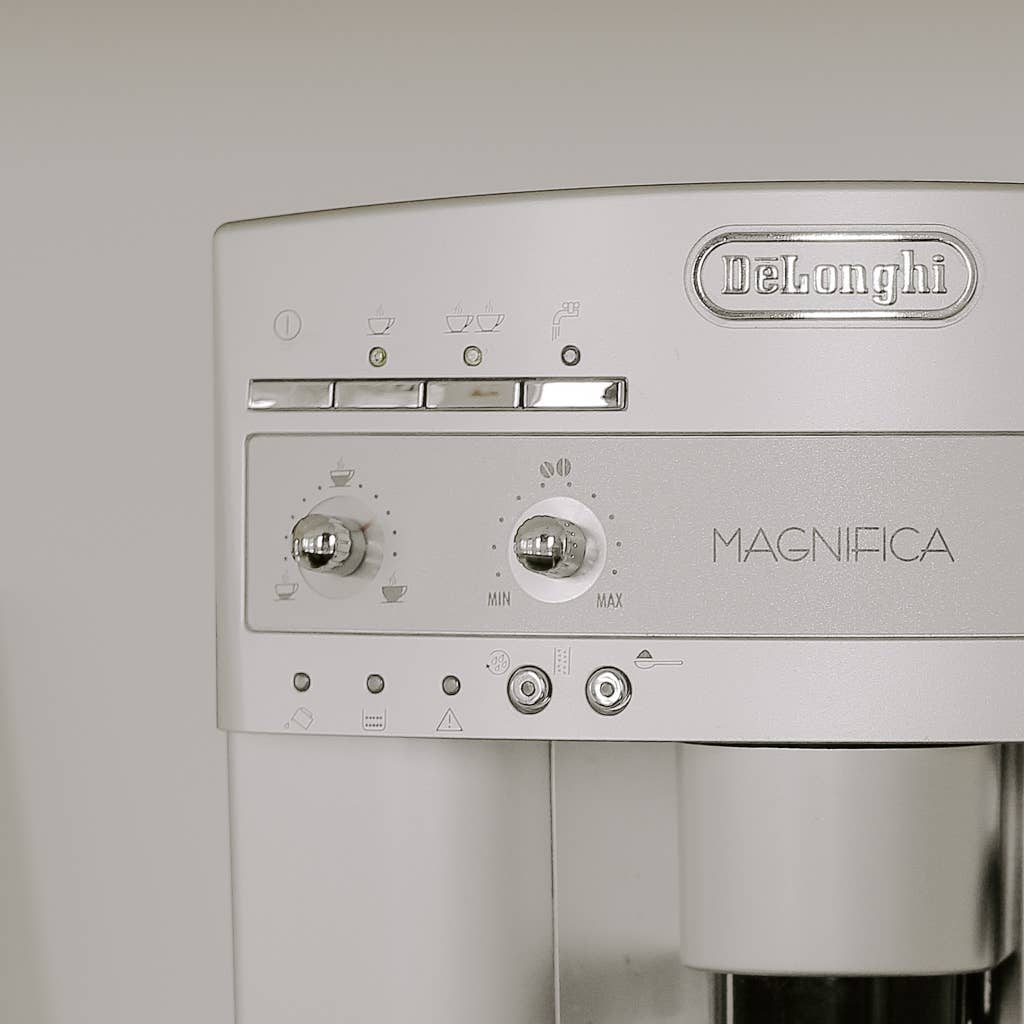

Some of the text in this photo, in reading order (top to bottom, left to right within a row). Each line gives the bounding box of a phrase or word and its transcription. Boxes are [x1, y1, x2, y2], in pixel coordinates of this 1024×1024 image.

[713, 526, 955, 562] MAGNIFICA
[487, 591, 511, 607] MIN
[596, 592, 623, 608] MAX
